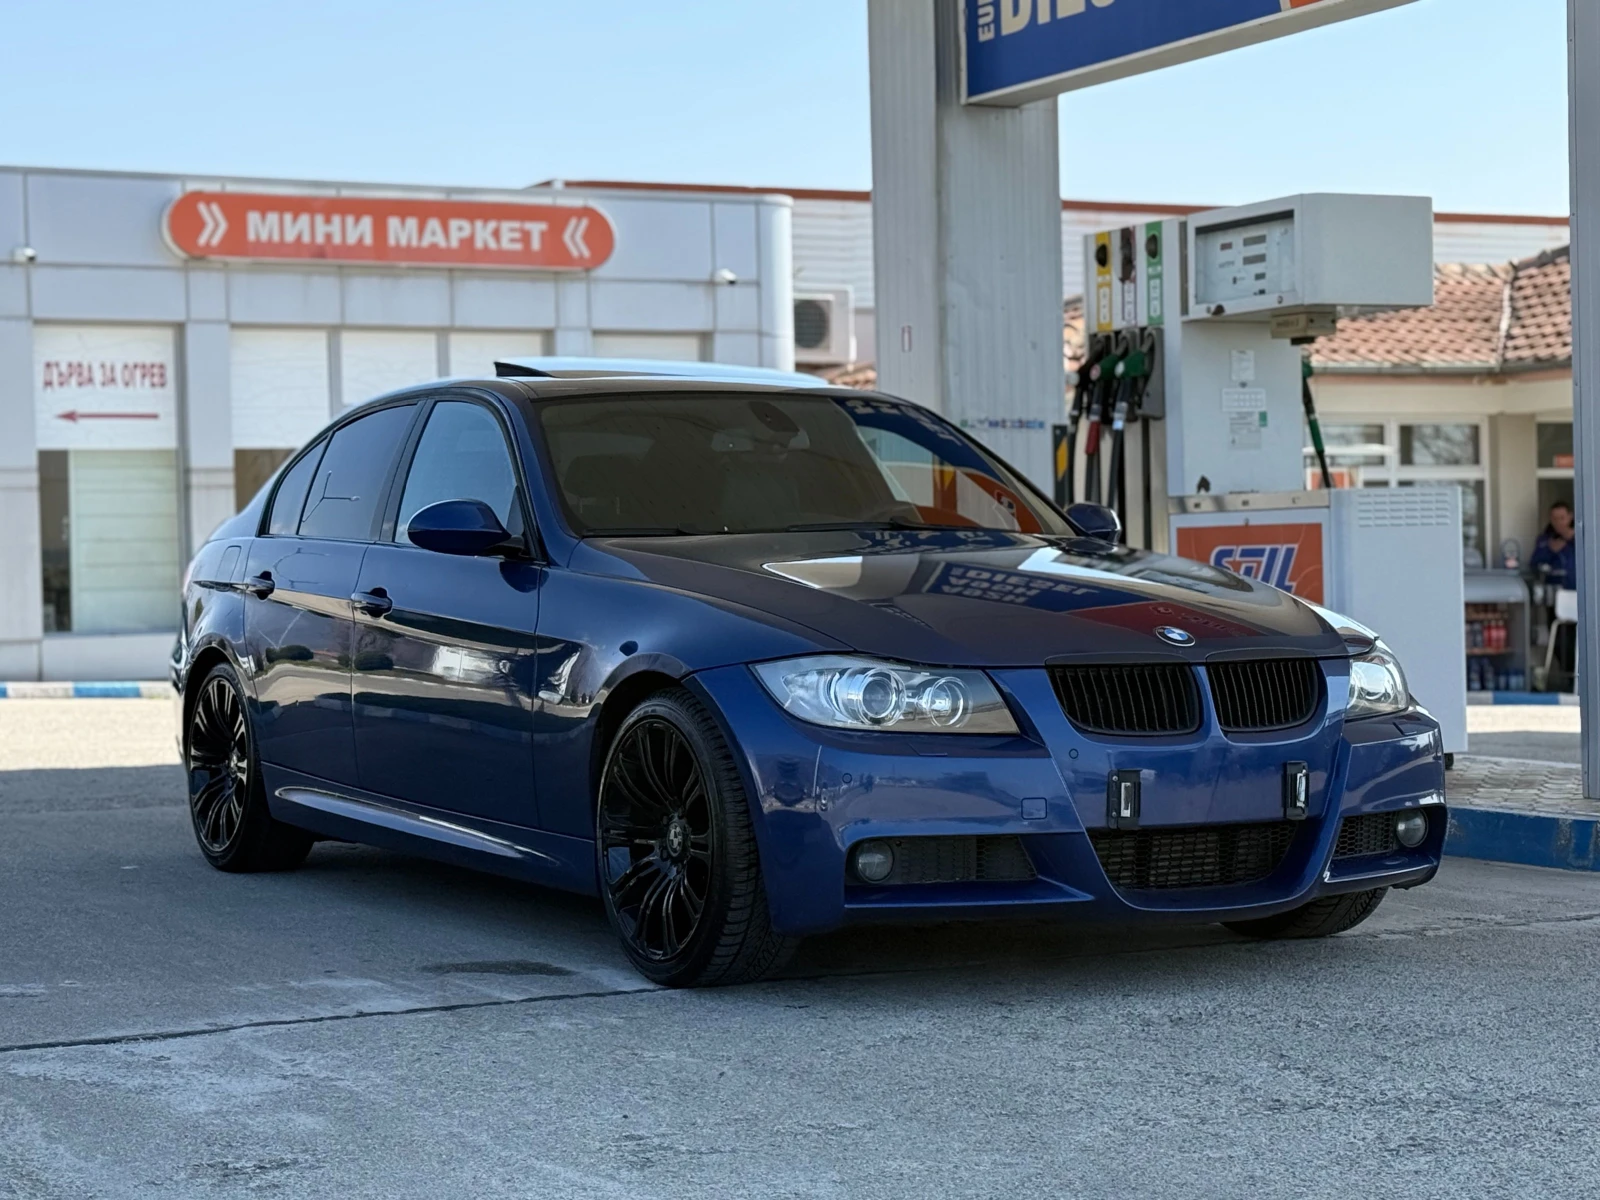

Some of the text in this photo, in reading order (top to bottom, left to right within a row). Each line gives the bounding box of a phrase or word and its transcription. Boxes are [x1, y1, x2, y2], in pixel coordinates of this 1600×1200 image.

[246, 211, 549, 252] МИНИ МАРКЕТ
[43, 361, 168, 391] ДЪРВА ЗА ОГРЕВ
